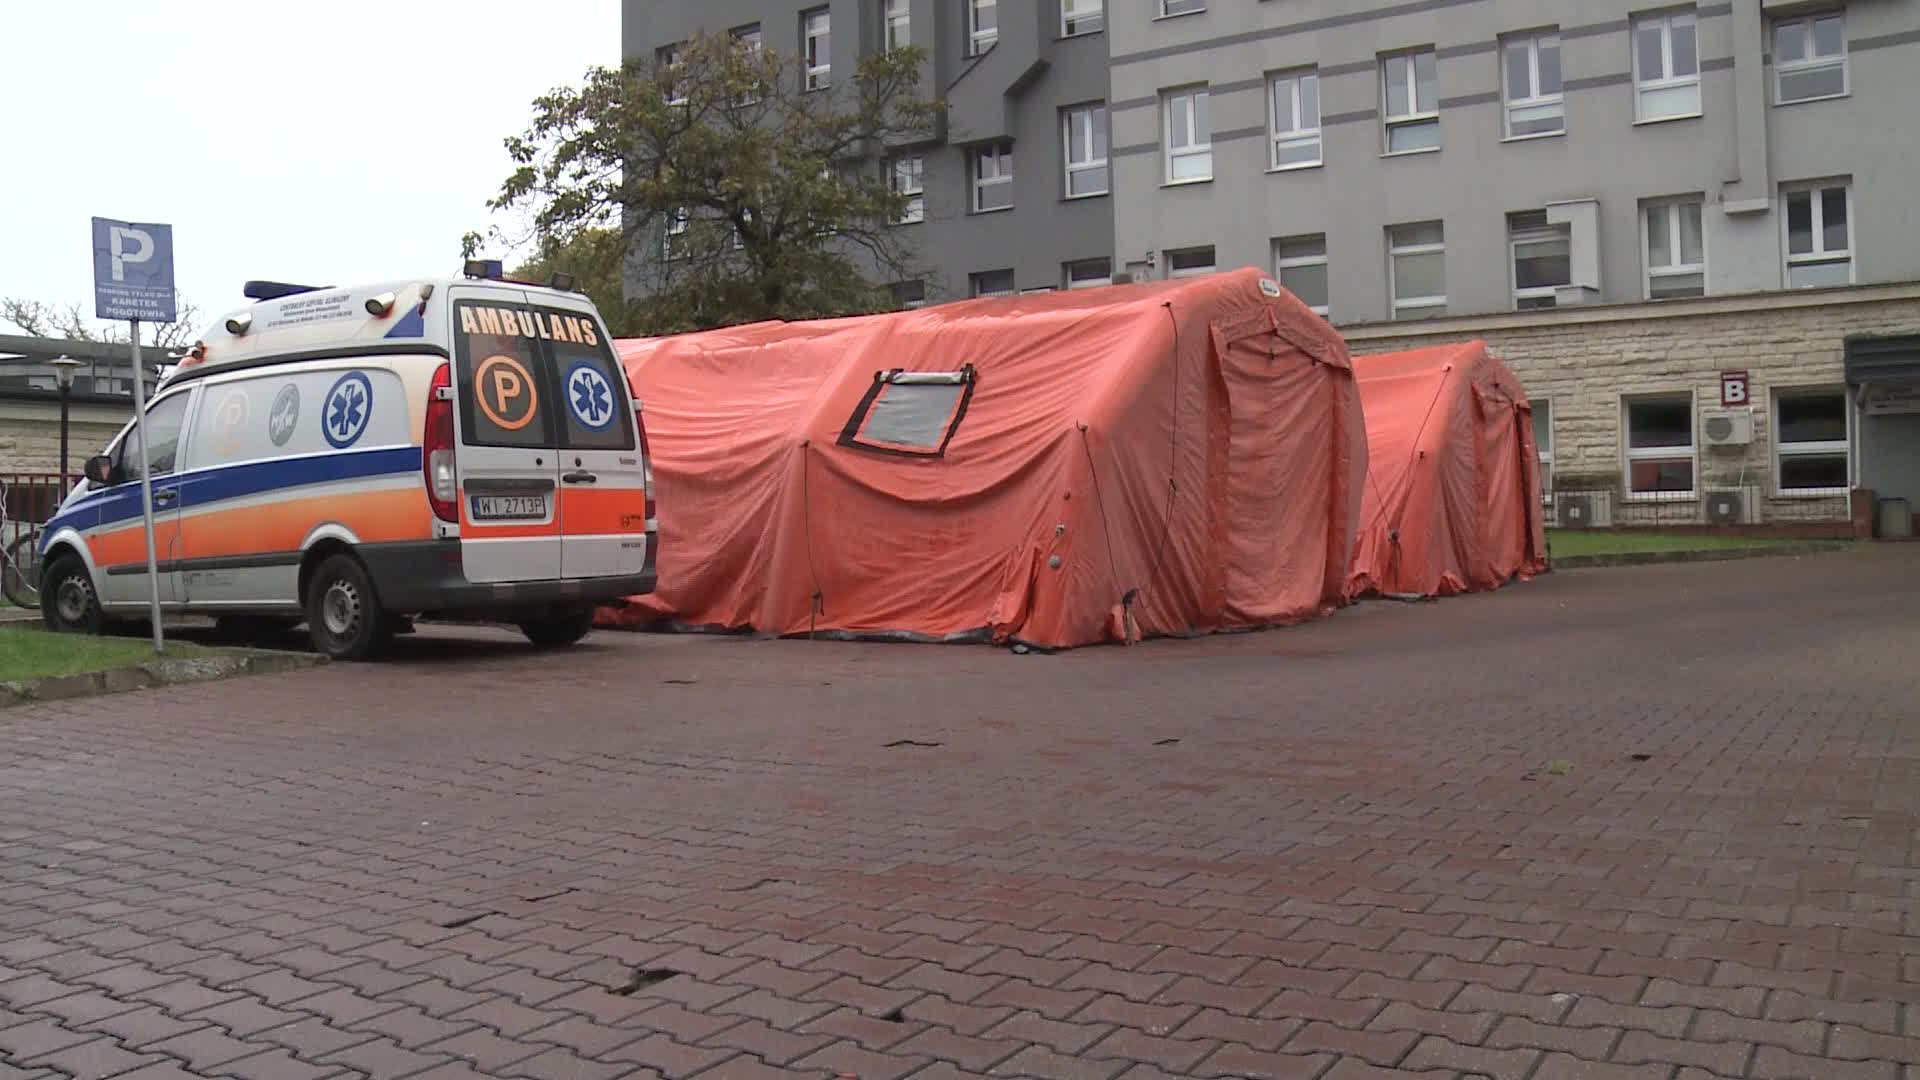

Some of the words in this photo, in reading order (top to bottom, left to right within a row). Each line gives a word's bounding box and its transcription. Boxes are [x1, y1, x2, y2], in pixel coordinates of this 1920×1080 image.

[110, 226, 154, 281] P
[105, 307, 166, 318] POGOTOWIA
[111, 297, 158, 307] KARETEK
[459, 306, 598, 347] AMBULANS
[494, 370, 521, 413] P
[1725, 380, 1746, 402] B
[481, 499, 498, 514] WI
[504, 498, 542, 513] 2713P
